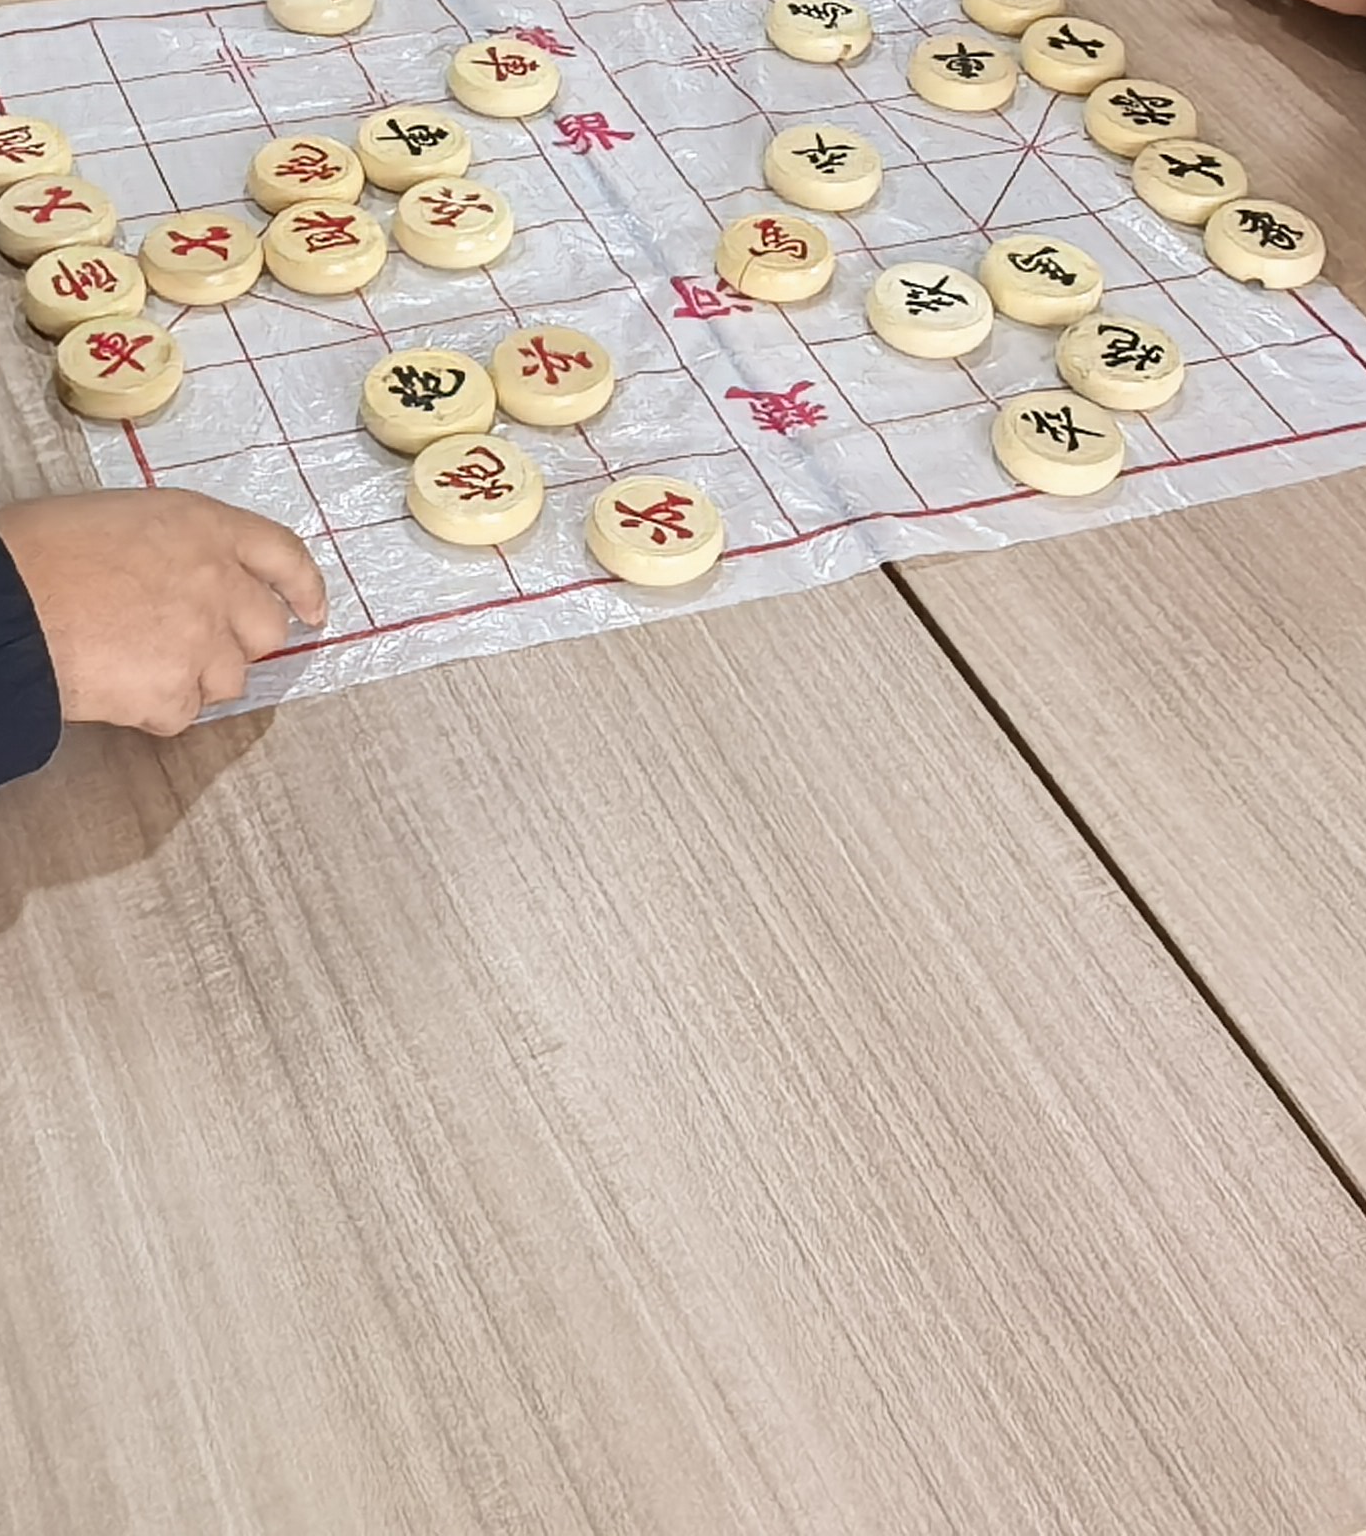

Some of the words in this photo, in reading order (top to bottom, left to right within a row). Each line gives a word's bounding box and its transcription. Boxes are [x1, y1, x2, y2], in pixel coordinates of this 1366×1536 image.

[471, 46, 541, 82] 車
[932, 42, 995, 79] 車
[383, 118, 449, 157] 車
[552, 111, 636, 156] 界
[791, 133, 855, 174] 卒
[275, 144, 342, 183] 炮
[417, 185, 494, 227] 兵
[749, 219, 807, 260] 馬
[1007, 246, 1077, 287] 馬
[899, 275, 969, 316] 卒
[86, 333, 153, 377] 車
[522, 336, 591, 385] 兵
[1097, 324, 1165, 371] 炮
[1020, 406, 1105, 452] 卒
[434, 447, 514, 500] 炮
[615, 493, 693, 545] 兵
